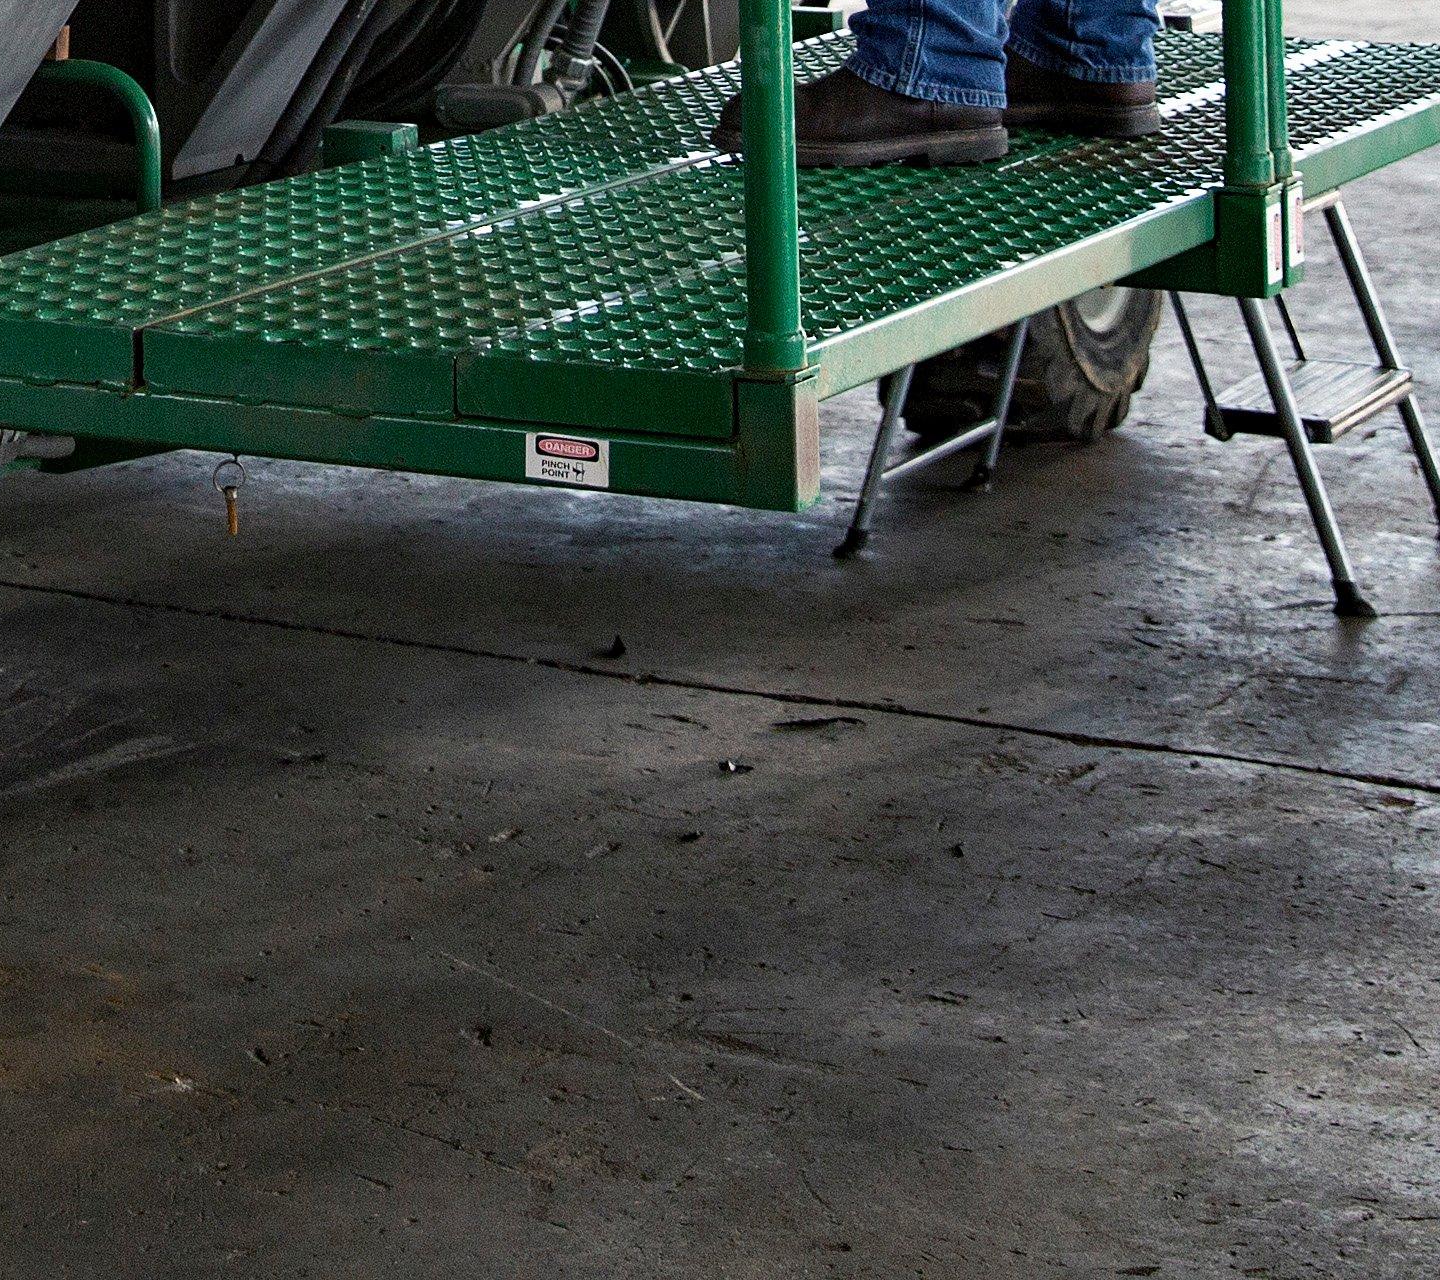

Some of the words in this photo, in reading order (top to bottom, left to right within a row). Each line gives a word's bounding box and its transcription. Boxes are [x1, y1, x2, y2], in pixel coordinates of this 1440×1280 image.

[545, 441, 590, 456] DANGER
[542, 460, 570, 470] PINCH
[542, 468, 570, 478] POINT
